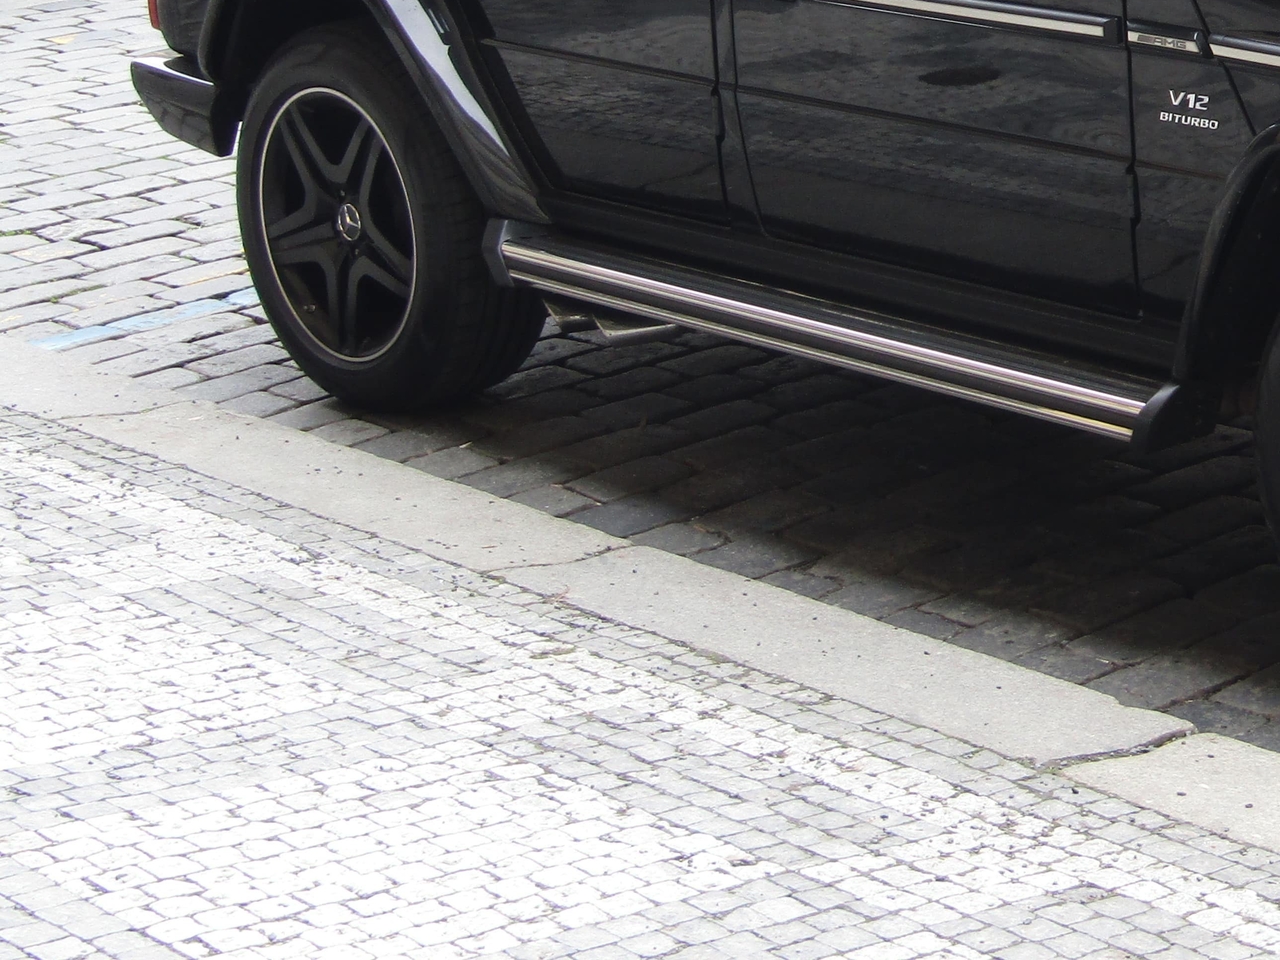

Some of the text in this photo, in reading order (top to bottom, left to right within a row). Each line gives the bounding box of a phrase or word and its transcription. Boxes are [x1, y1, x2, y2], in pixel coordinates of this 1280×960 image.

[1152, 37, 1187, 50] AMG
[1168, 89, 1210, 111] V12
[1159, 111, 1219, 130] BITURBO
